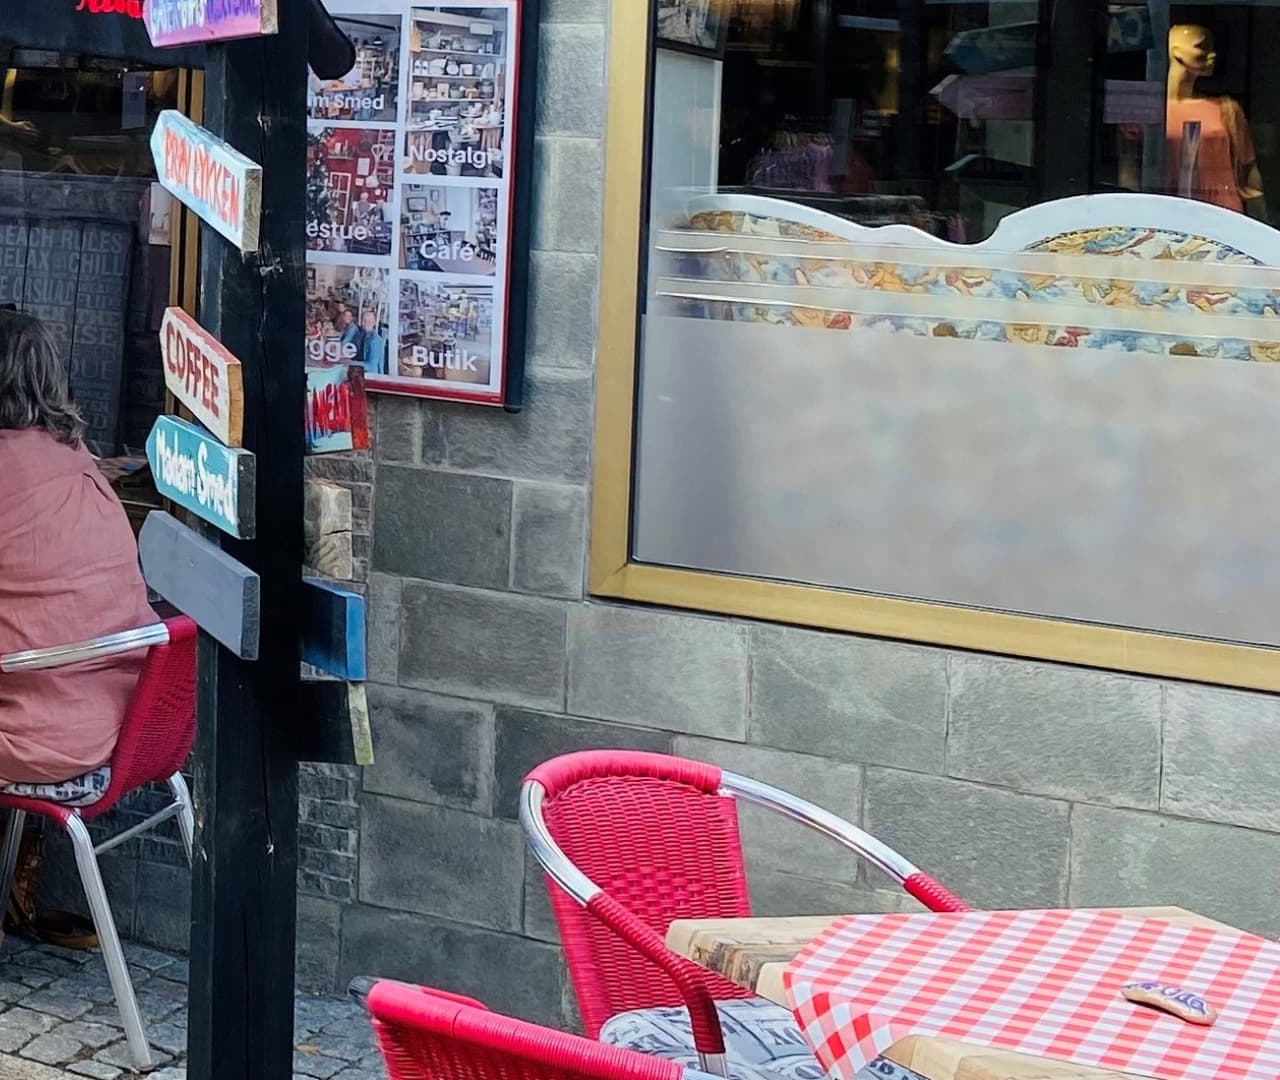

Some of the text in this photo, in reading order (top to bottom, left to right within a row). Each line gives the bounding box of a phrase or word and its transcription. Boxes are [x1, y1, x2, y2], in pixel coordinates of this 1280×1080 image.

[334, 93, 385, 111] Smed
[408, 145, 493, 168] Nostalgi
[60, 229, 123, 254] RULES
[419, 238, 475, 263] Café
[67, 251, 124, 276] CHILL
[164, 319, 221, 419] COFFEE
[411, 344, 478, 373] Butik
[155, 428, 236, 527] Madam Smed
